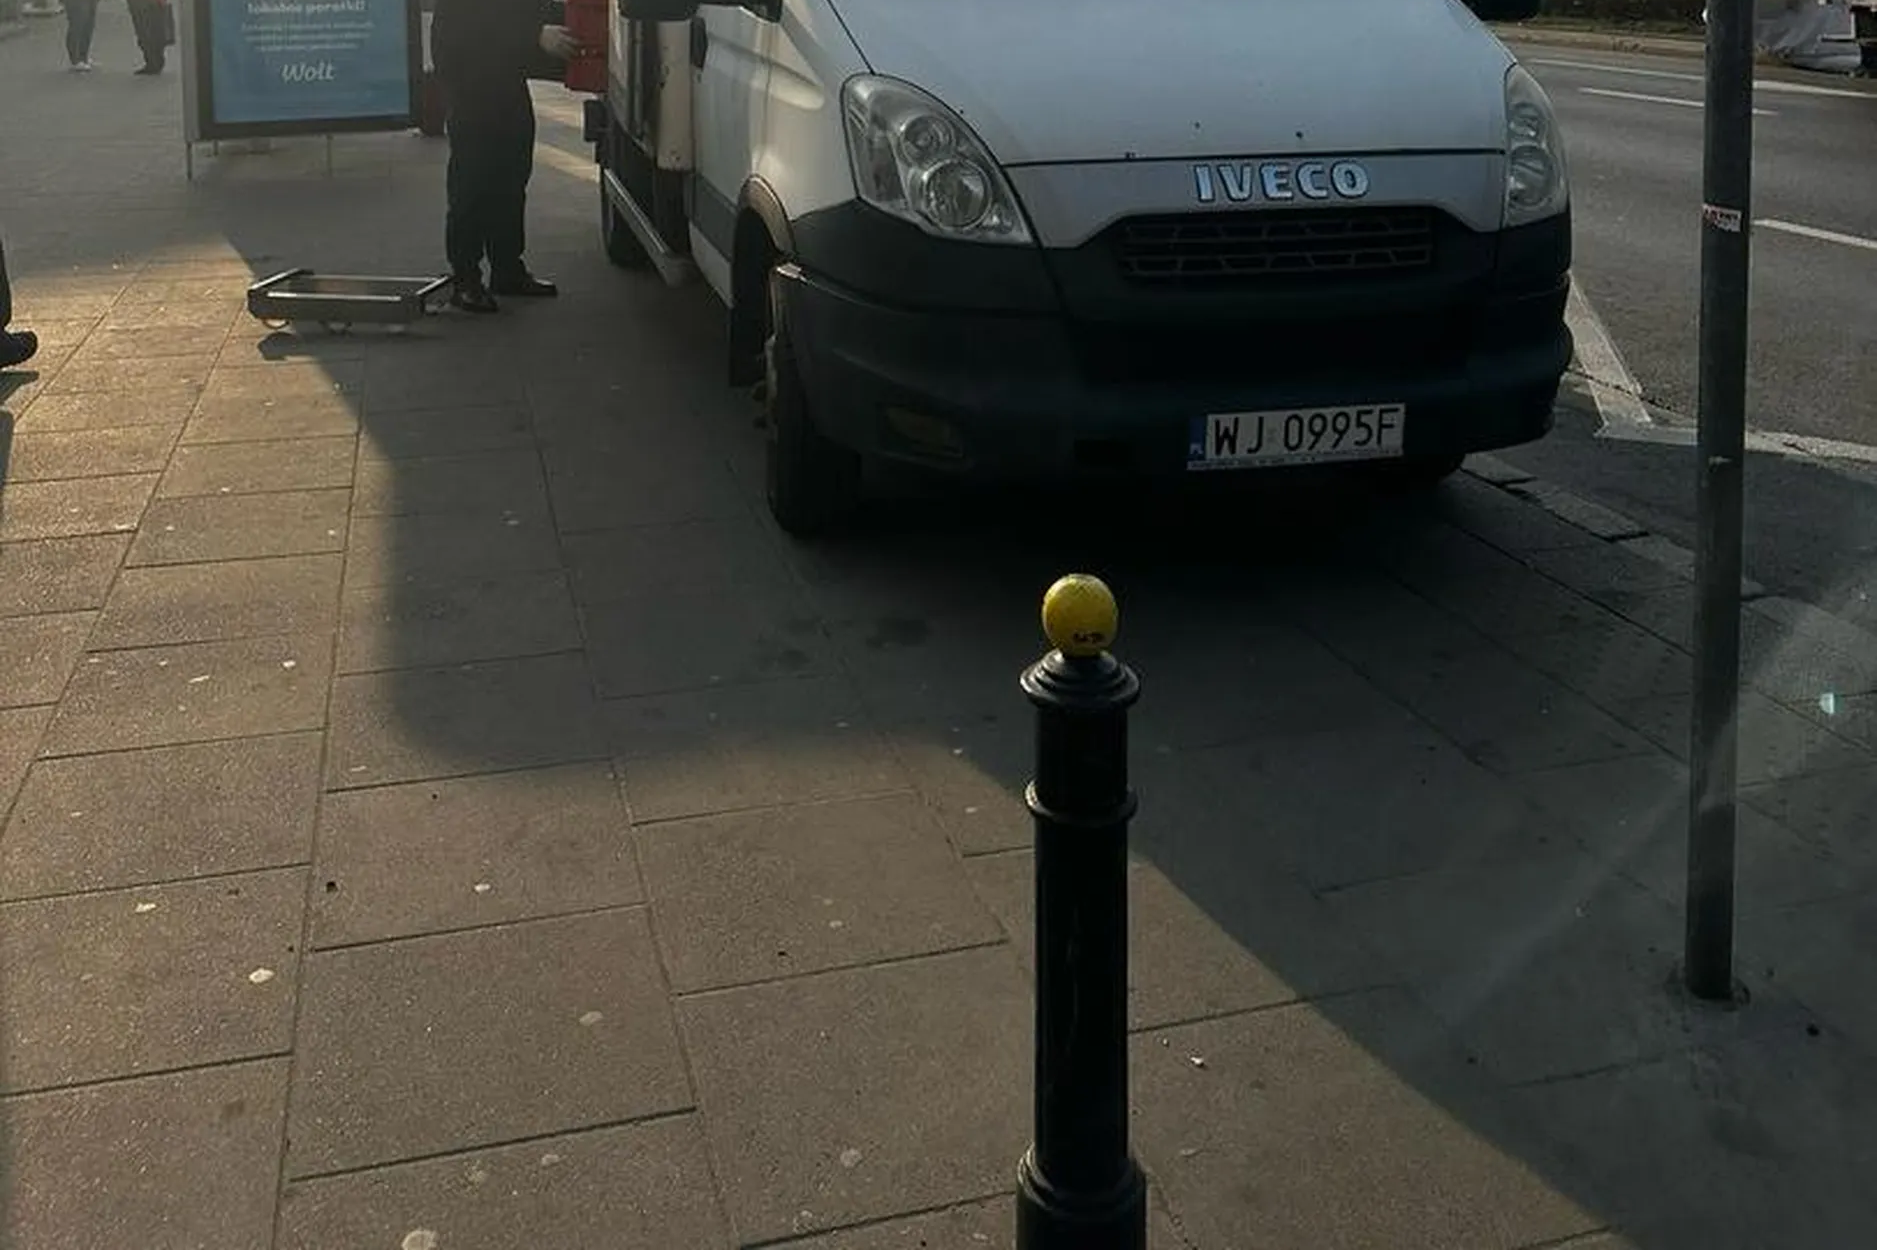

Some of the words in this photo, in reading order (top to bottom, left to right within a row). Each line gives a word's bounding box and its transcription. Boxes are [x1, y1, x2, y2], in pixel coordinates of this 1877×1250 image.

[282, 61, 336, 82] Wolt
[1194, 160, 1370, 201] IVECO
[1213, 416, 1265, 456] WJ
[1283, 408, 1400, 452] 0995F
